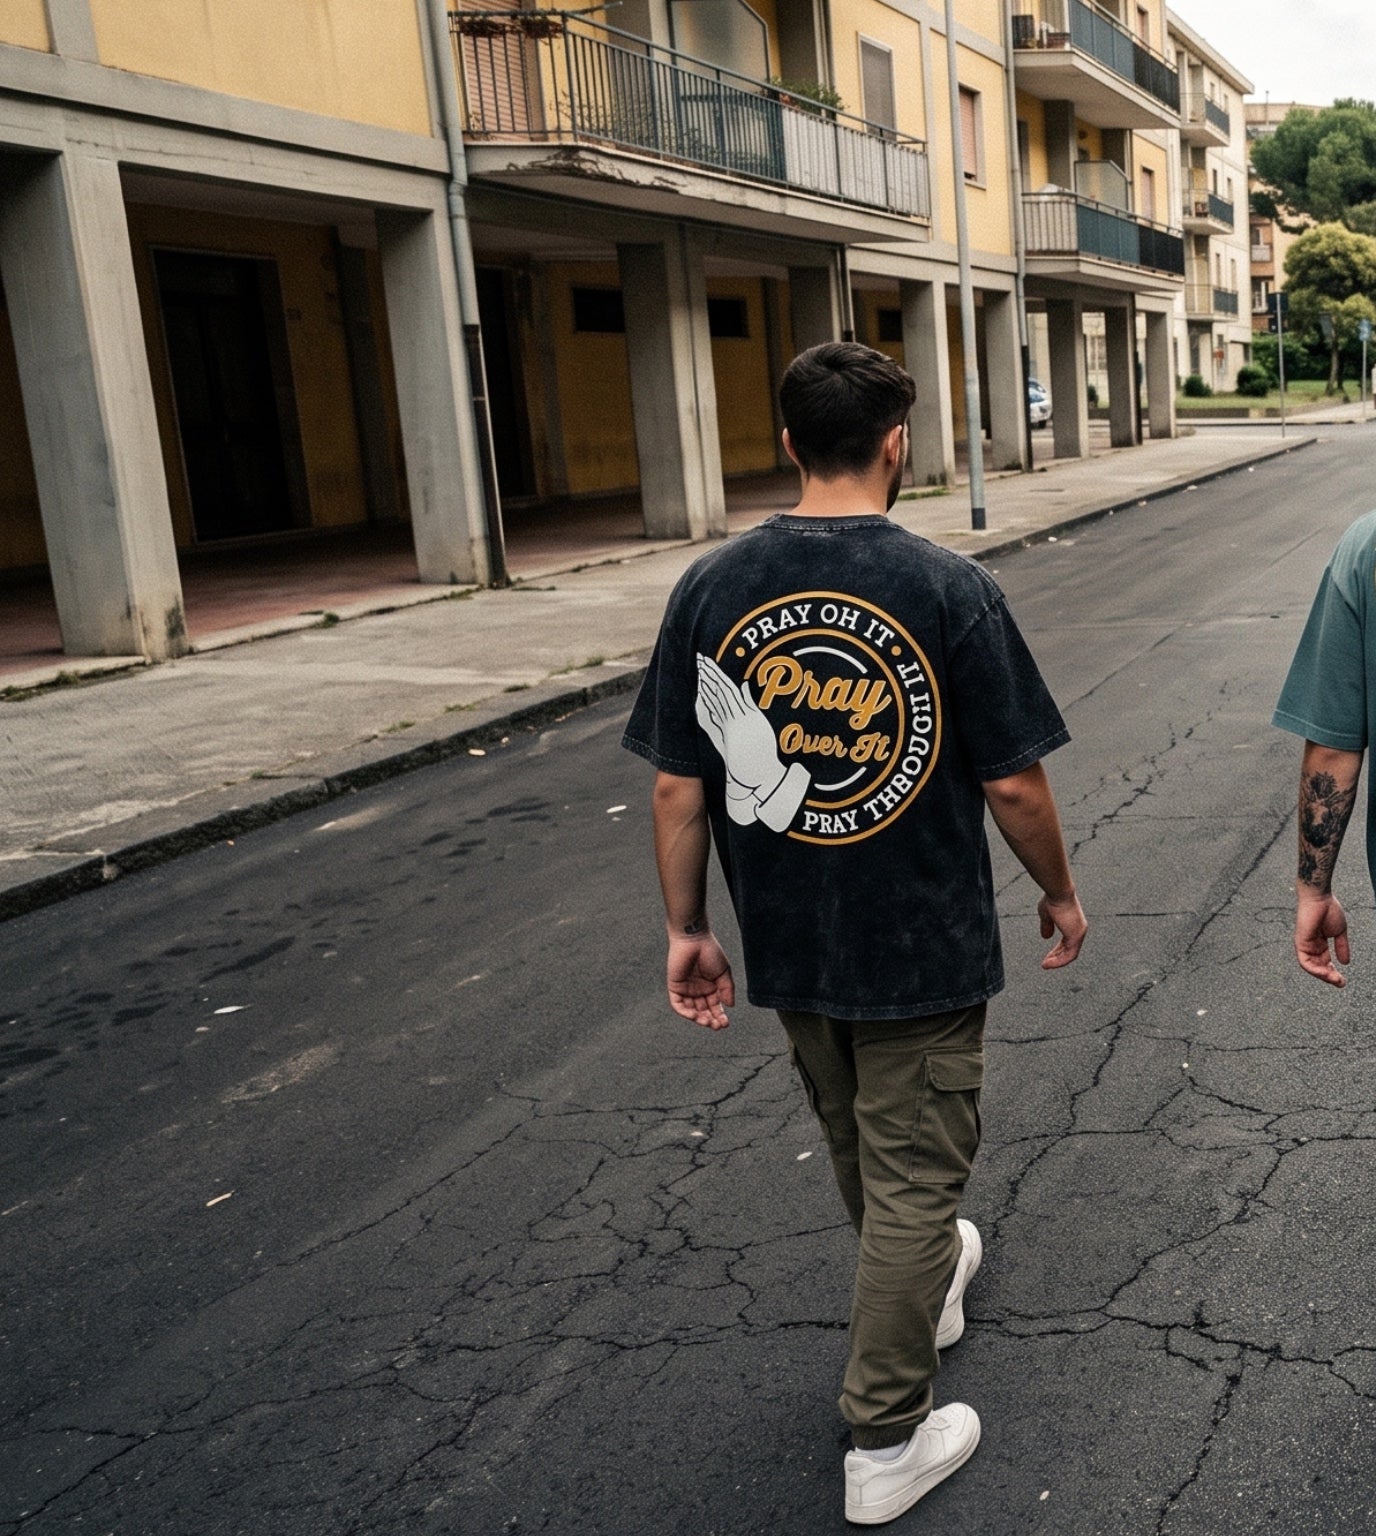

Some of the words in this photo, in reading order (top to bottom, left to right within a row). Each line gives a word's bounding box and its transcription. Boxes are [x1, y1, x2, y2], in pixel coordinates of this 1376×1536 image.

[742, 603, 812, 650] PRAY
[820, 603, 861, 630] OH
[863, 619, 895, 648] IT
[757, 655, 892, 730] Pray
[779, 723, 848, 758] Over
[849, 732, 890, 763] It
[802, 810, 860, 834] PRAY
